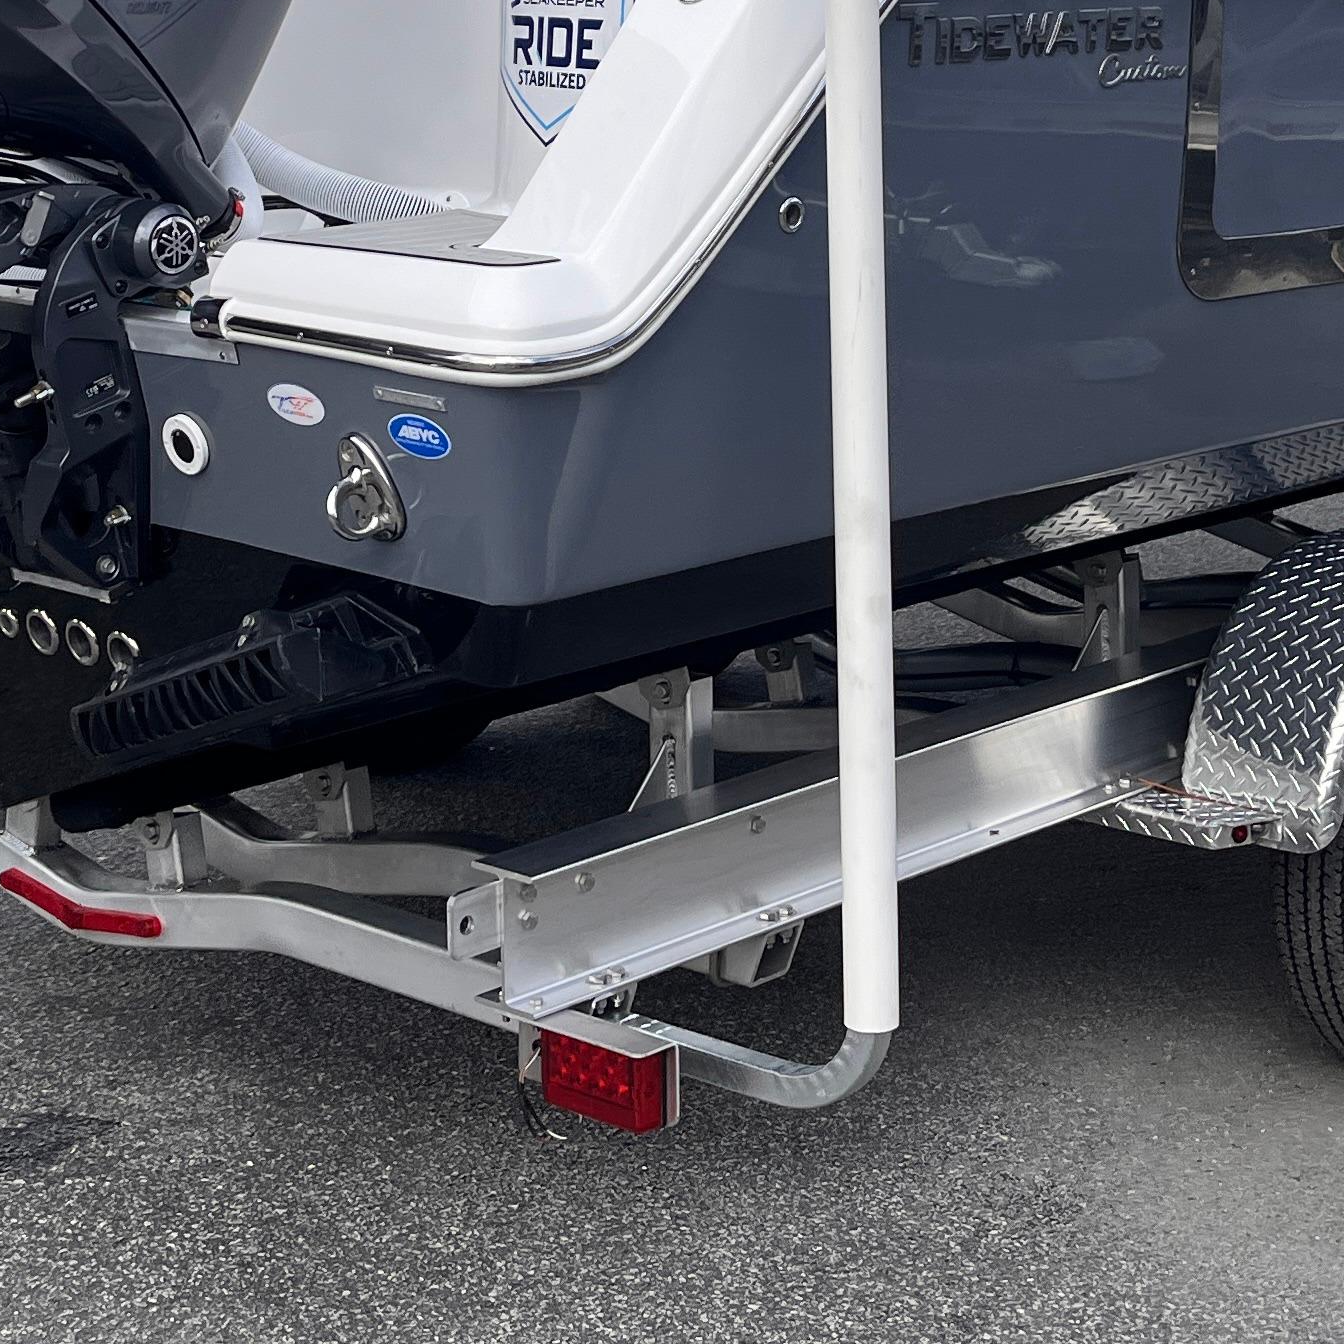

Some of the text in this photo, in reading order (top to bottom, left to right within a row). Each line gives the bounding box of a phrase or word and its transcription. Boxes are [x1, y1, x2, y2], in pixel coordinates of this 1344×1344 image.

[511, 14, 604, 70] RIDE
[518, 69, 587, 90] STABILIZED
[397, 425, 440, 445] ABYC
